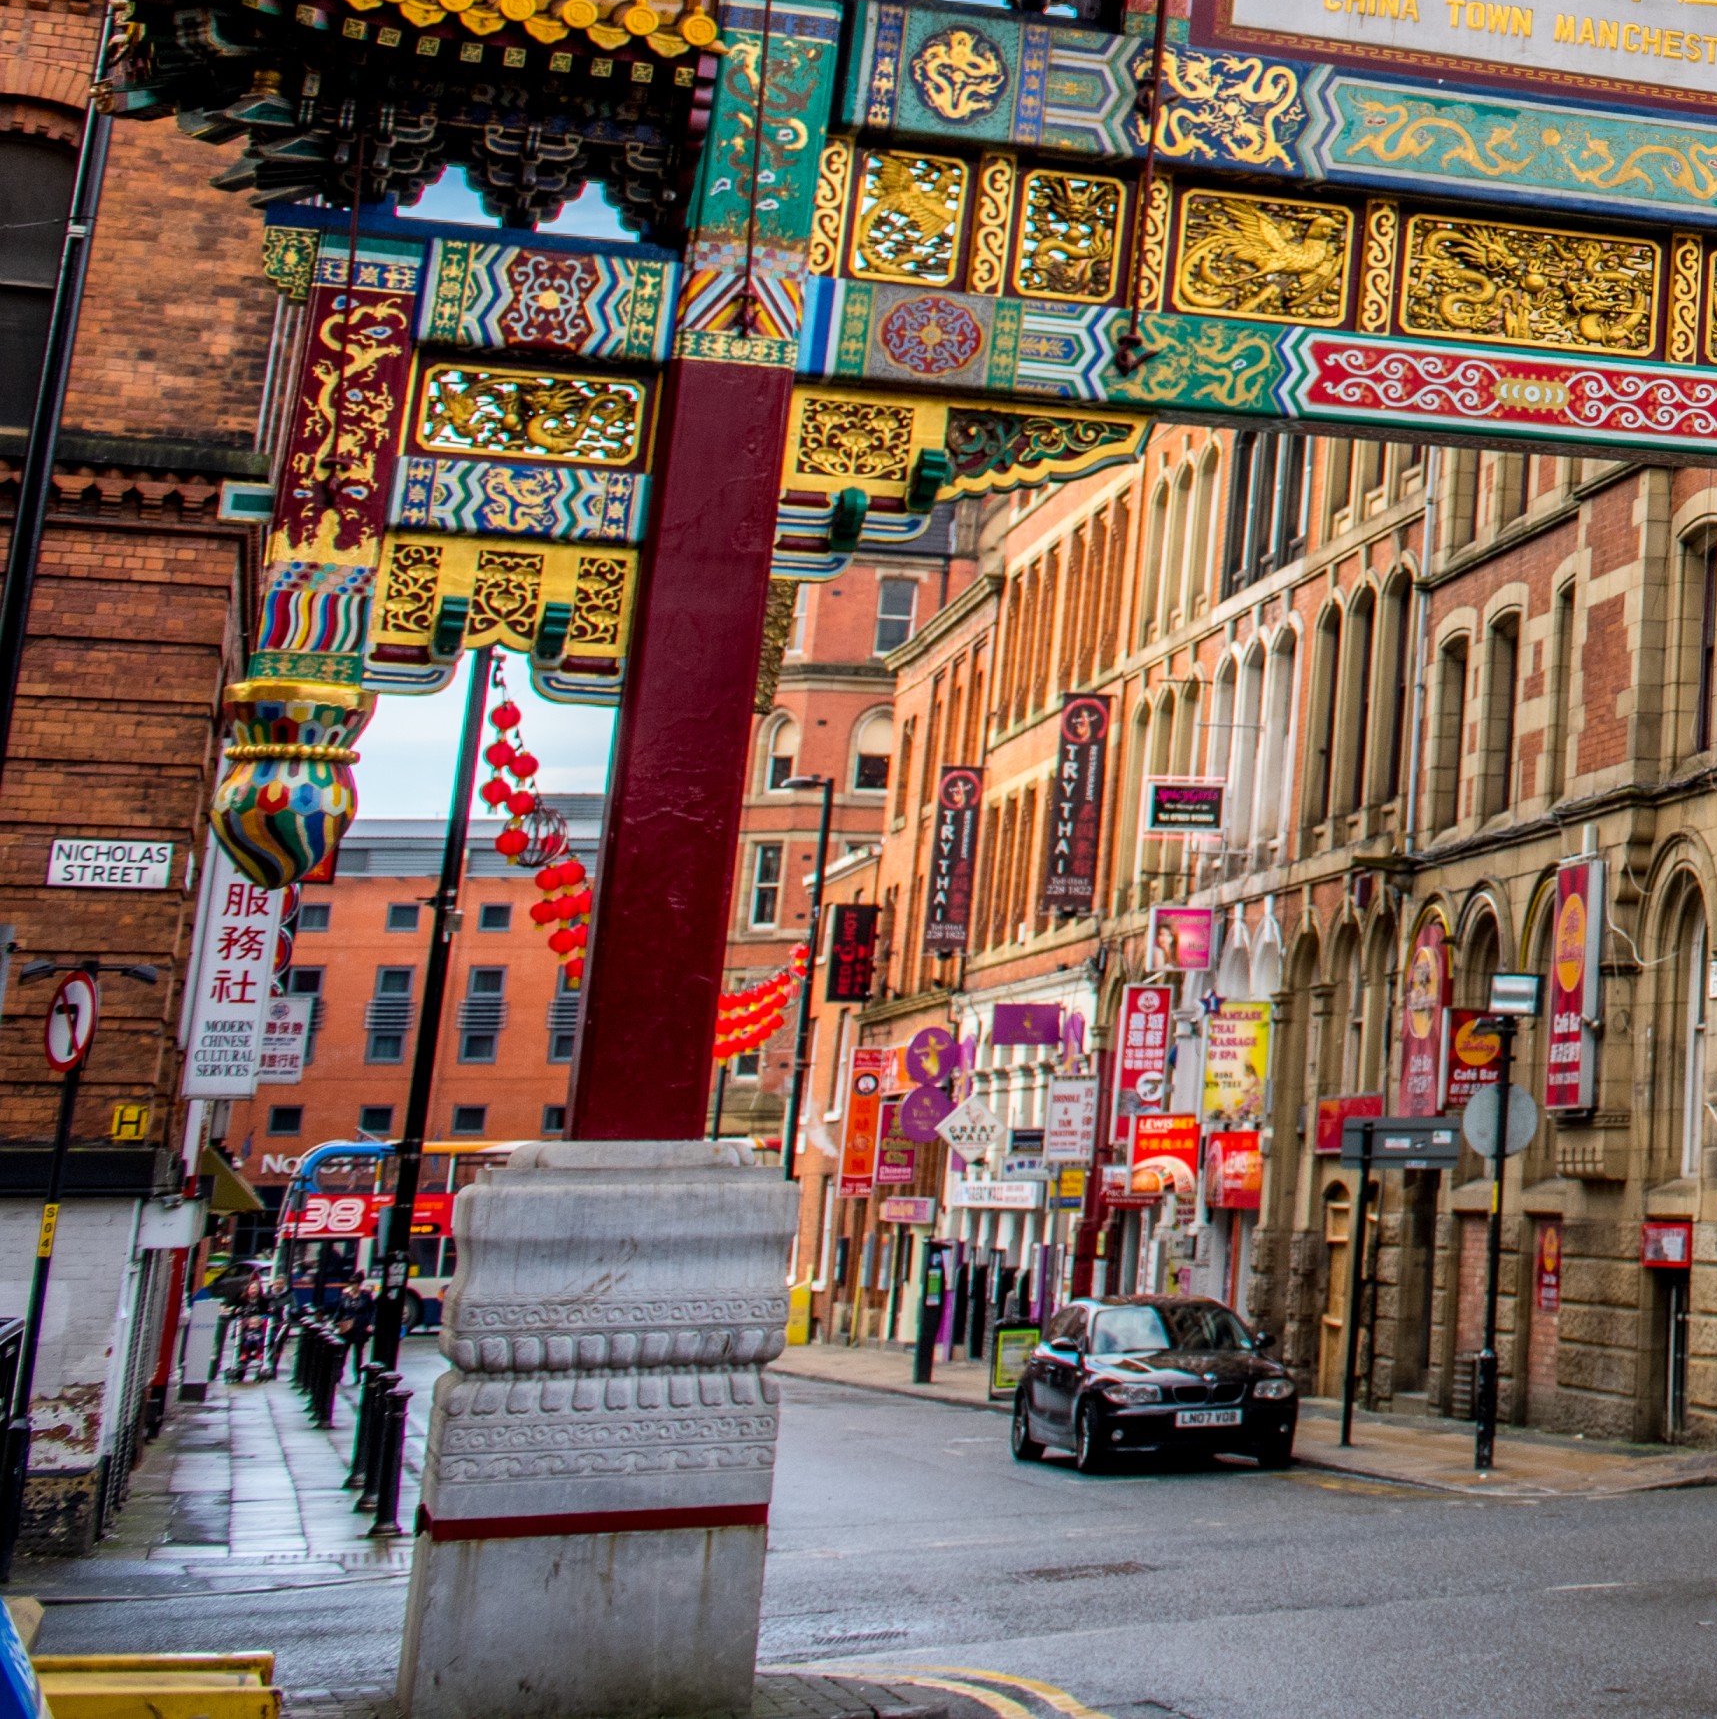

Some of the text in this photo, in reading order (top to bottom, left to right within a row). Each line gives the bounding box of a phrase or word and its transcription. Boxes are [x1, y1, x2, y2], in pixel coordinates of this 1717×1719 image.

[56, 844, 168, 864] NICHOLAS
[62, 865, 149, 883] STREET
[209, 868, 271, 1004] 服務社
[205, 1021, 255, 1033] MODERN
[201, 1035, 251, 1048] CHINESE
[195, 1050, 256, 1063] CULTURAL
[196, 1064, 249, 1077] SERVICES
[948, 1125, 996, 1134] GREAT
[950, 1134, 992, 1142] WALL
[305, 1198, 365, 1232] 38
